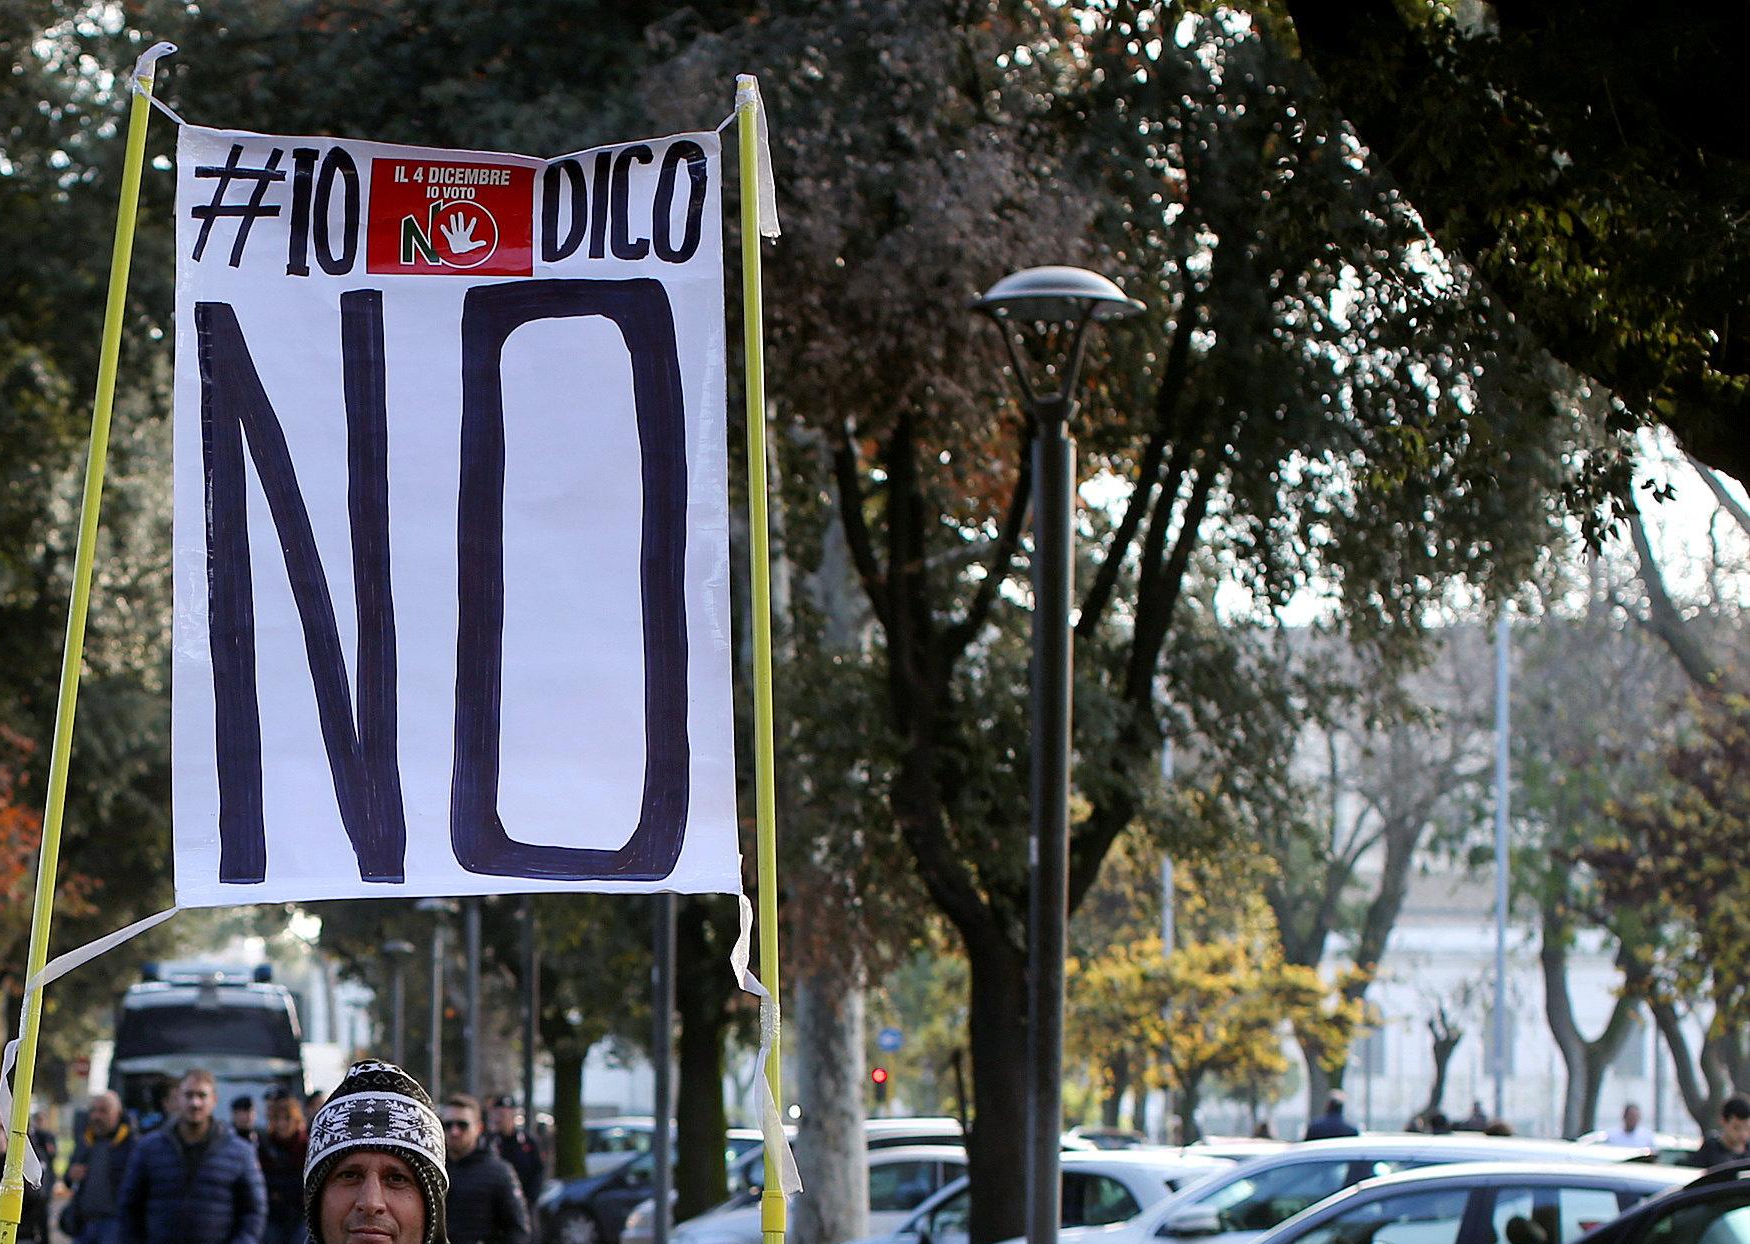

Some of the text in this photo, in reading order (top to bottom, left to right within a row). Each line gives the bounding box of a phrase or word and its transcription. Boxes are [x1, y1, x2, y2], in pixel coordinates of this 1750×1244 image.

[191, 140, 709, 276] #IO DICO
[394, 165, 512, 186] IL 4 DICEMBRE
[426, 186, 476, 200] IO VOTO
[194, 278, 690, 885] NO
